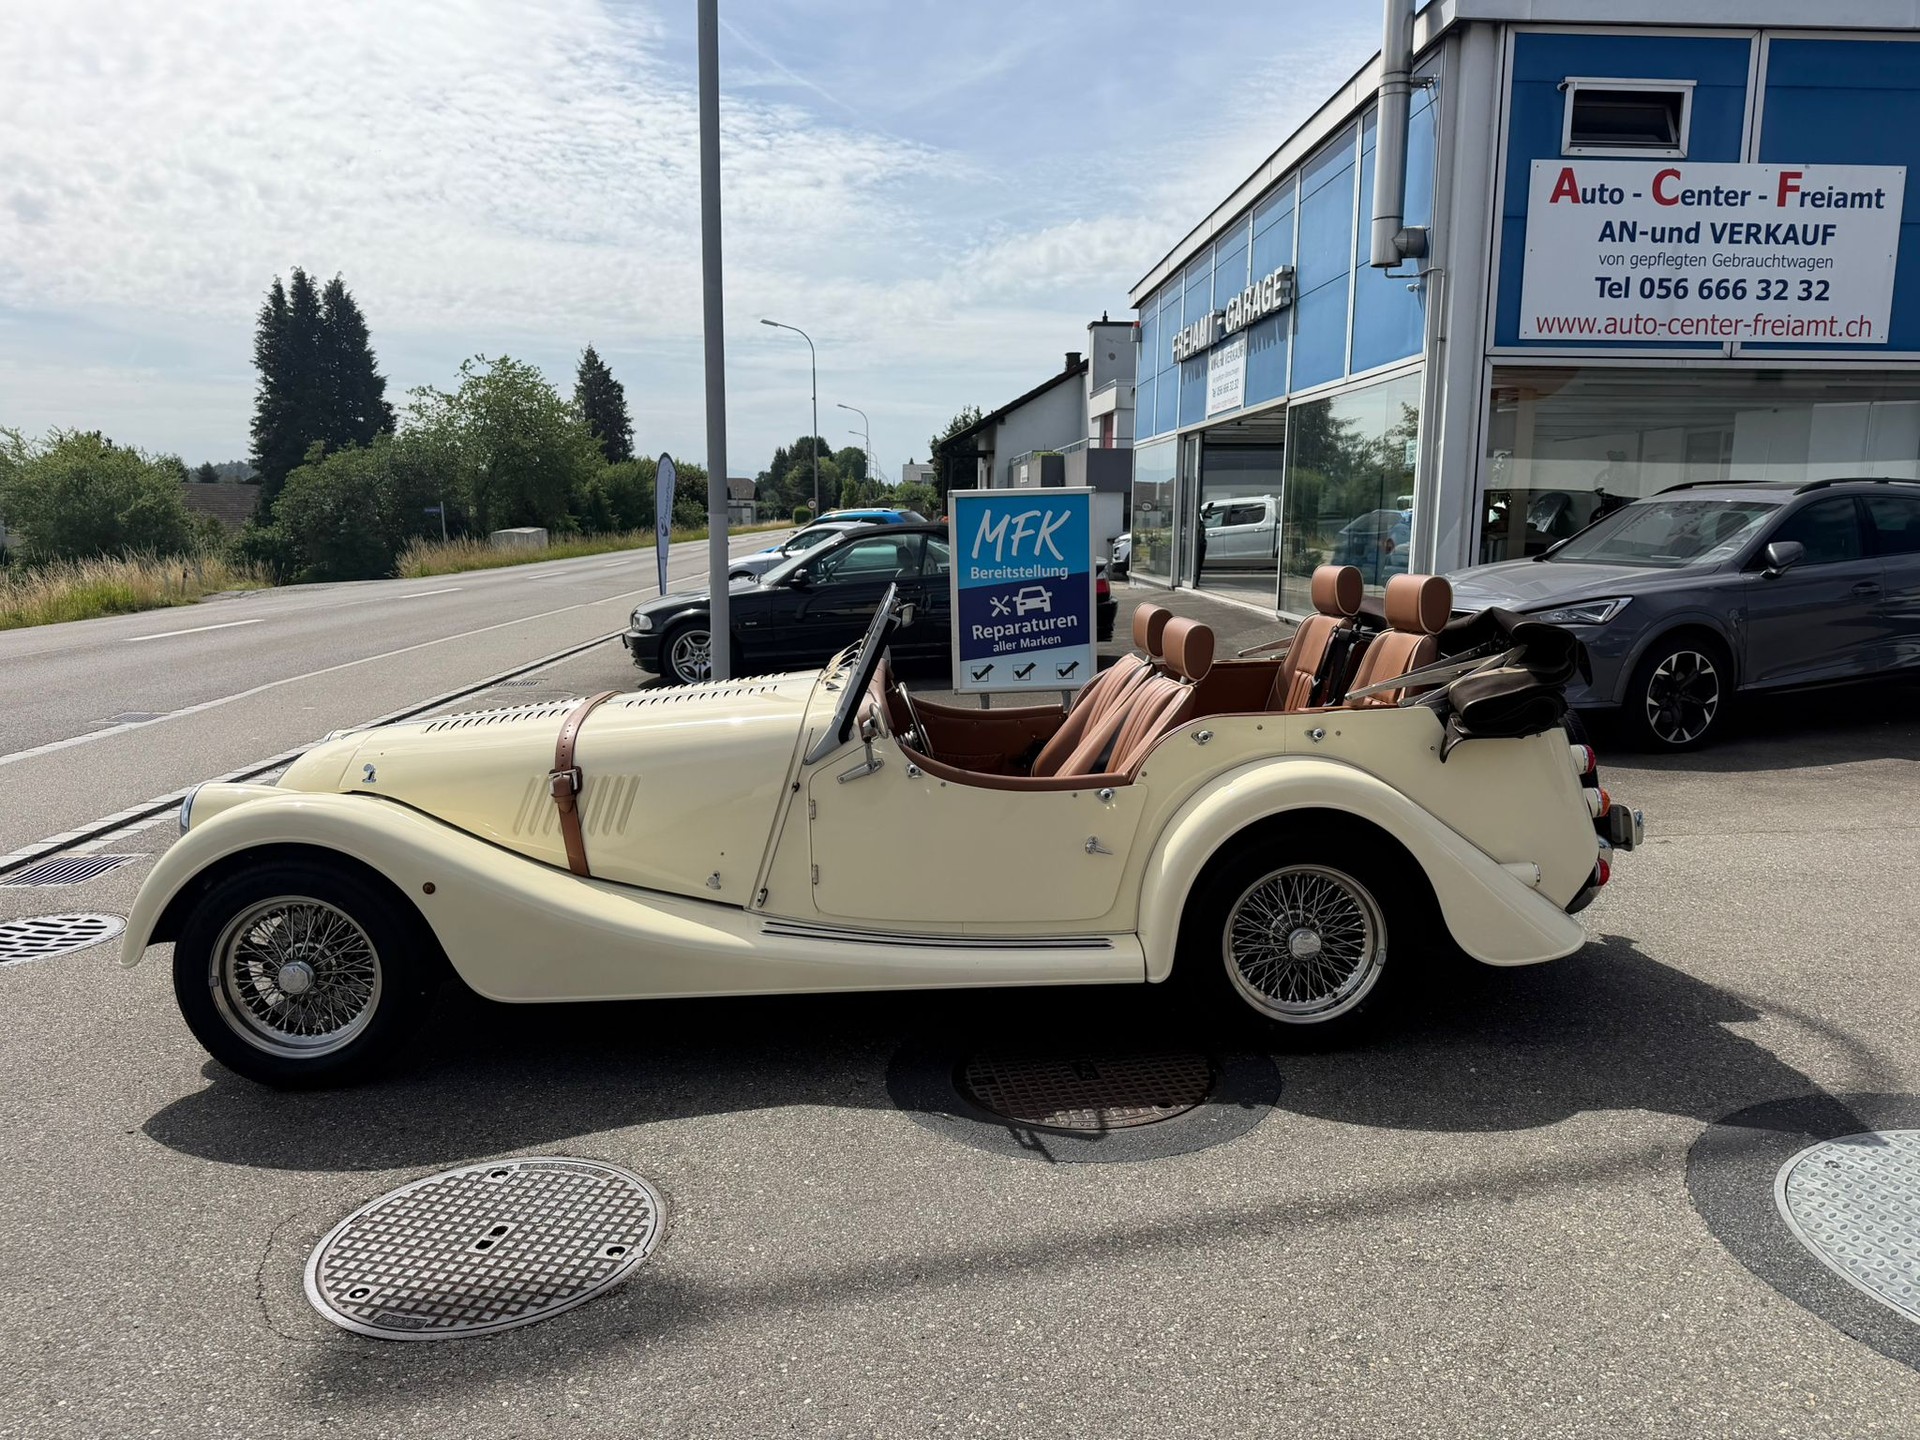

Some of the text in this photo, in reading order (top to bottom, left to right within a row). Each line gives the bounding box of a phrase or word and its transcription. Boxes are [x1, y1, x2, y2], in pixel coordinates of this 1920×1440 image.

[1550, 167, 1625, 205] Auto
[1652, 168, 1751, 207] Center
[1777, 171, 1886, 209] Freiamt
[1598, 220, 1837, 246] AN-und VERKAUF
[1598, 252, 1834, 272] von gepflegten Gebrauchtwagen
[1225, 265, 1288, 333] GARAGE
[1595, 276, 1830, 302] Tel 056 666 32 32
[1536, 313, 1872, 338] www.auto-center-freiamt.ch
[971, 509, 1072, 562] MFK
[970, 564, 1069, 581] Bereitstellung
[972, 614, 1078, 641] Reparaturen
[992, 634, 1062, 653] aller Marken
